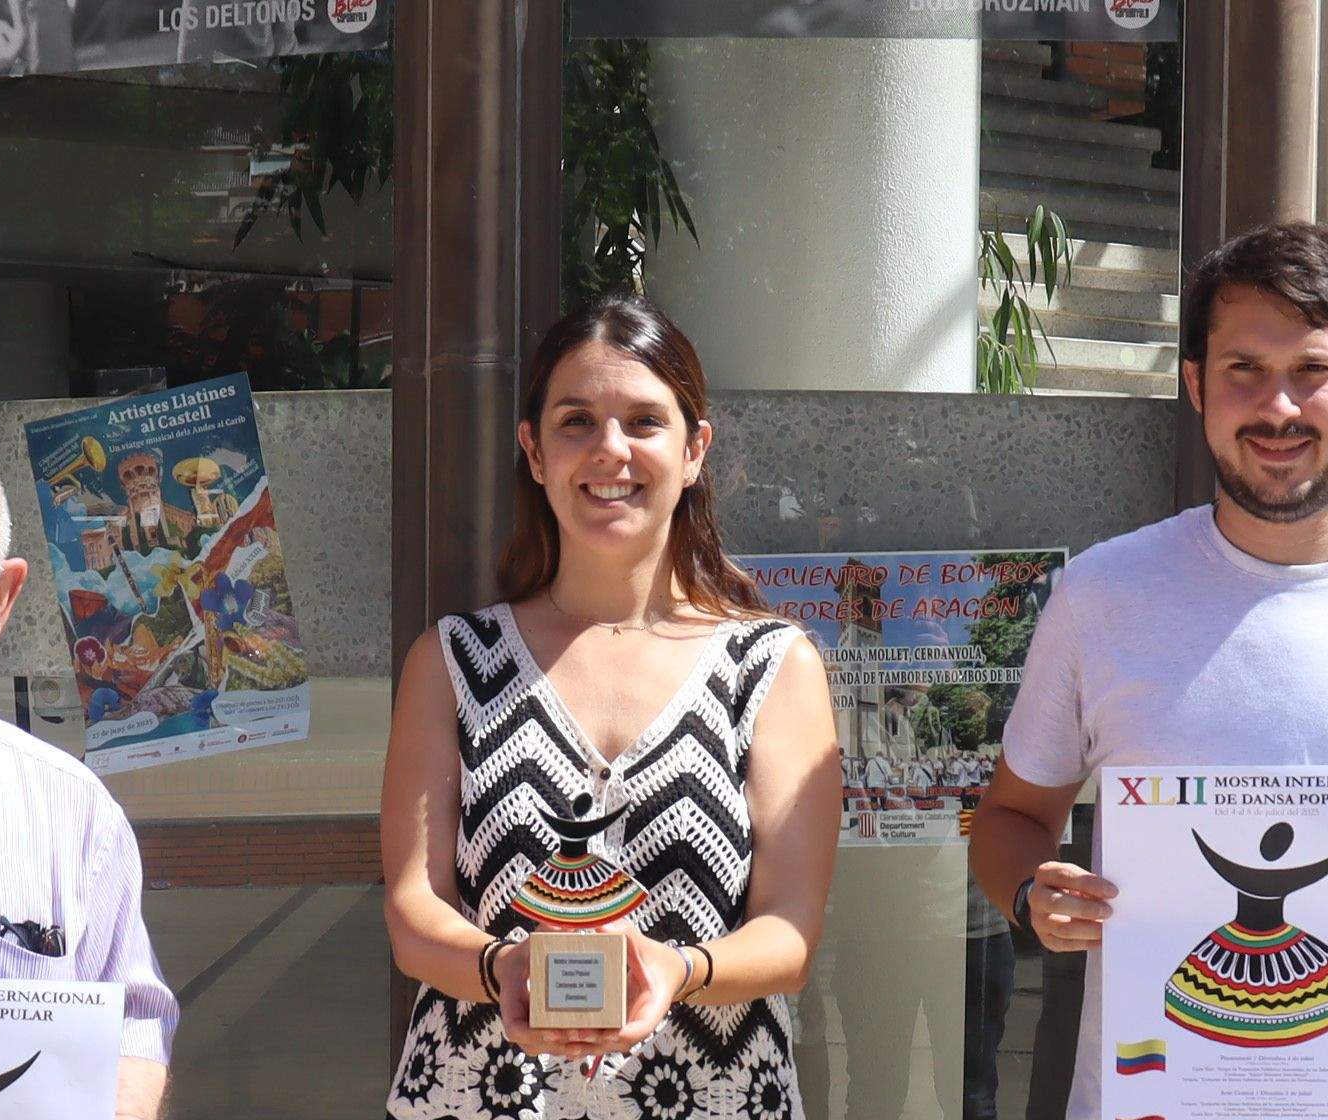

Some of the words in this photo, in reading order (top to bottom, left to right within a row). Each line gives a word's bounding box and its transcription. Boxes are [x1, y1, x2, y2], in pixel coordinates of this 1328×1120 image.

[158, 7, 199, 32] LOS
[205, 0, 316, 29] DELTONOS
[107, 399, 170, 425] Artistes
[171, 385, 236, 410] Llatines
[140, 419, 156, 434] al
[158, 404, 213, 430] Castell
[146, 431, 175, 446] musical
[175, 428, 191, 440] dels
[191, 422, 216, 436] Andes
[898, 563, 931, 586] DE
[941, 560, 1048, 585] BOMBOS
[777, 599, 864, 621] BORES
[871, 598, 904, 621] DE
[823, 648, 867, 664] CELONA,
[869, 647, 912, 664] MOLLET,
[914, 646, 987, 664] CERDANYOLA,
[827, 671, 861, 685] BANDA
[863, 671, 876, 685] DE
[879, 670, 933, 685] TAMBORES
[935, 670, 943, 684] Y
[944, 669, 989, 684] BOMBOS
[990, 669, 1003, 683] DE
[1006, 669, 1024, 683] BIN
[833, 695, 856, 709] NDA
[1117, 776, 1208, 806] XLII
[1214, 775, 1282, 789] MOSTRA
[1214, 793, 1239, 805] DE
[1241, 793, 1296, 806] DANSA
[880, 822, 925, 832] Departament
[890, 830, 916, 838] Cultura
